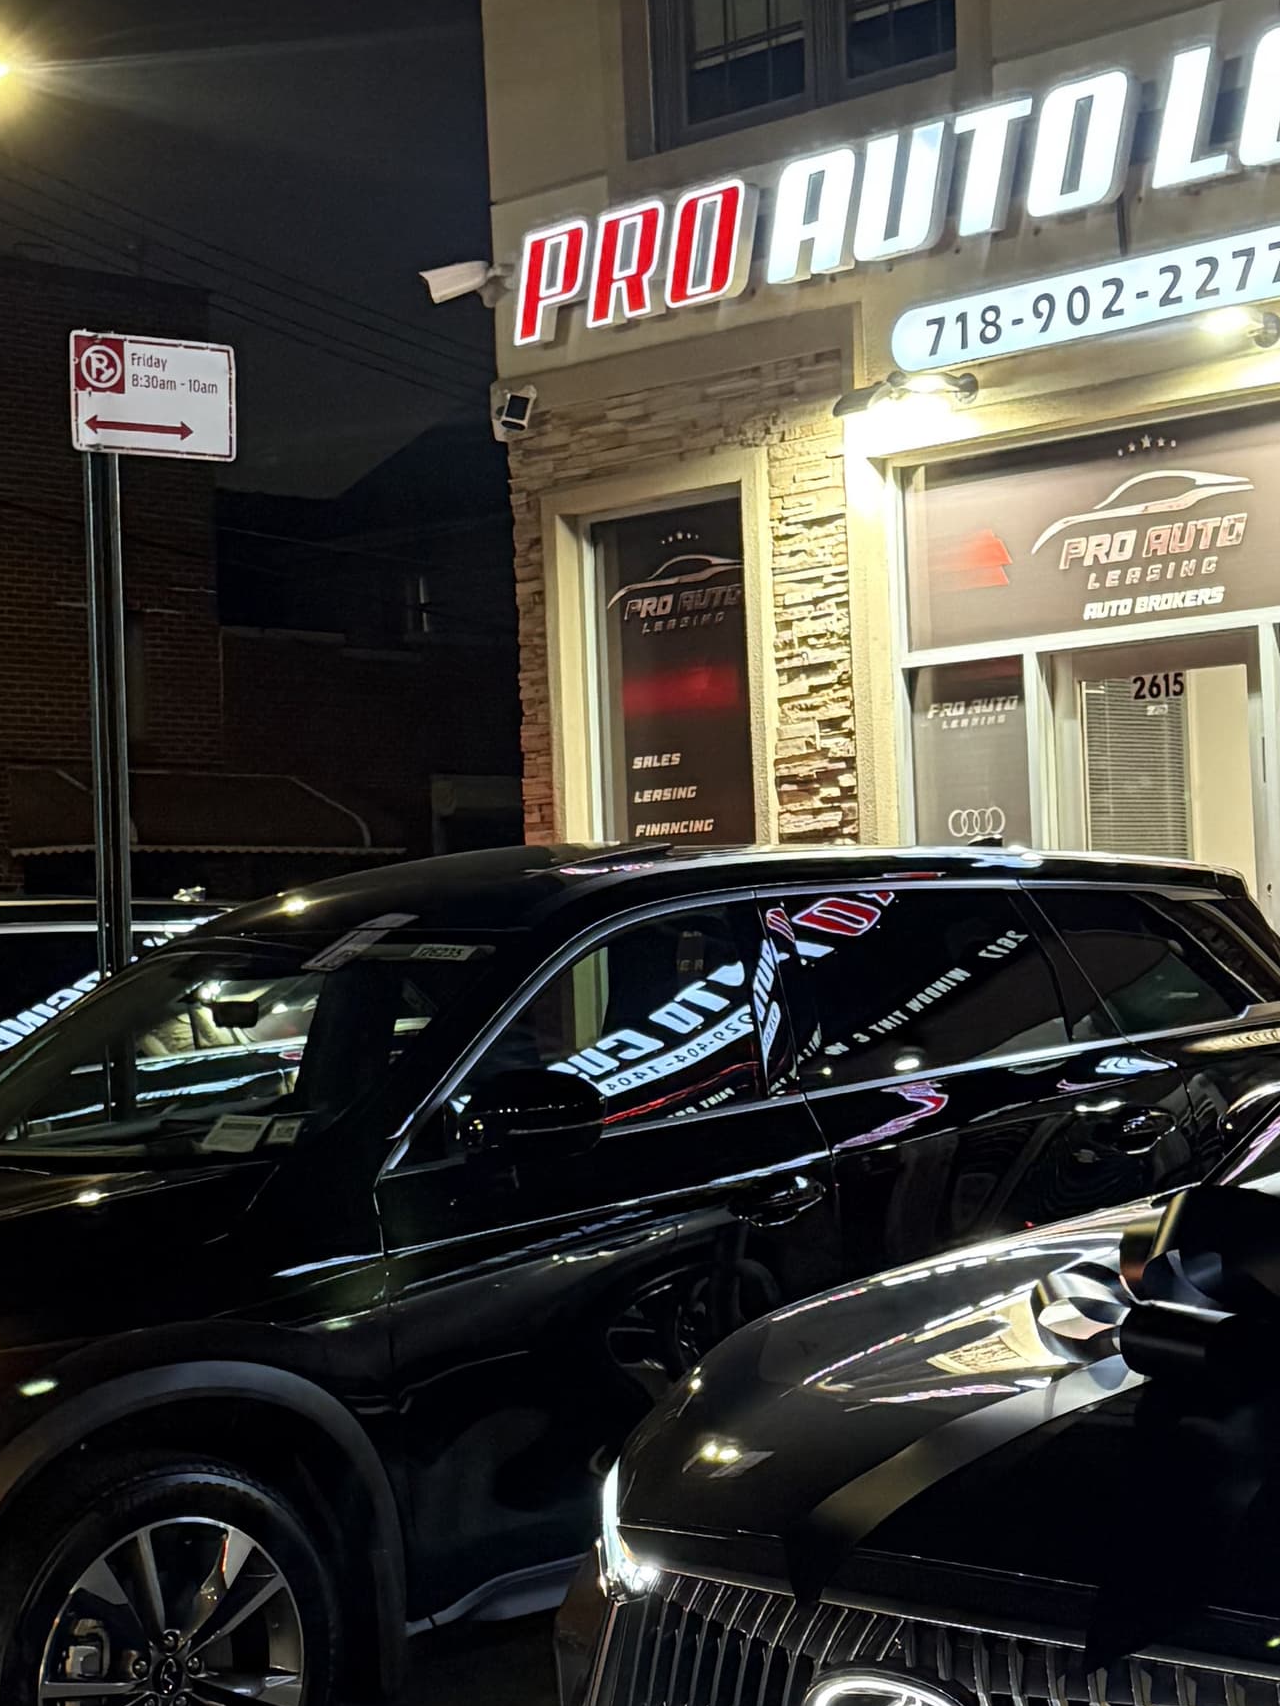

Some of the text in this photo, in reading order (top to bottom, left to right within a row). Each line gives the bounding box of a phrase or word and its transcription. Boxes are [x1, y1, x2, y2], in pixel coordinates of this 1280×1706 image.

[513, 179, 752, 347] PRO
[766, 69, 1132, 286] AUTO
[130, 352, 168, 372] Friday
[131, 373, 177, 391] 8:30am
[188, 378, 218, 394] 10am
[1059, 512, 1248, 570] PRO AUTO
[1087, 555, 1218, 591] LEASING
[623, 583, 742, 621] PRO AUTO
[1083, 585, 1226, 621] AUTO BROKERS
[1132, 671, 1185, 701] 2615
[967, 695, 1019, 716] AUTO
[632, 753, 681, 770] SALES
[634, 785, 697, 804] LEASING
[635, 818, 715, 838] FINANCING
